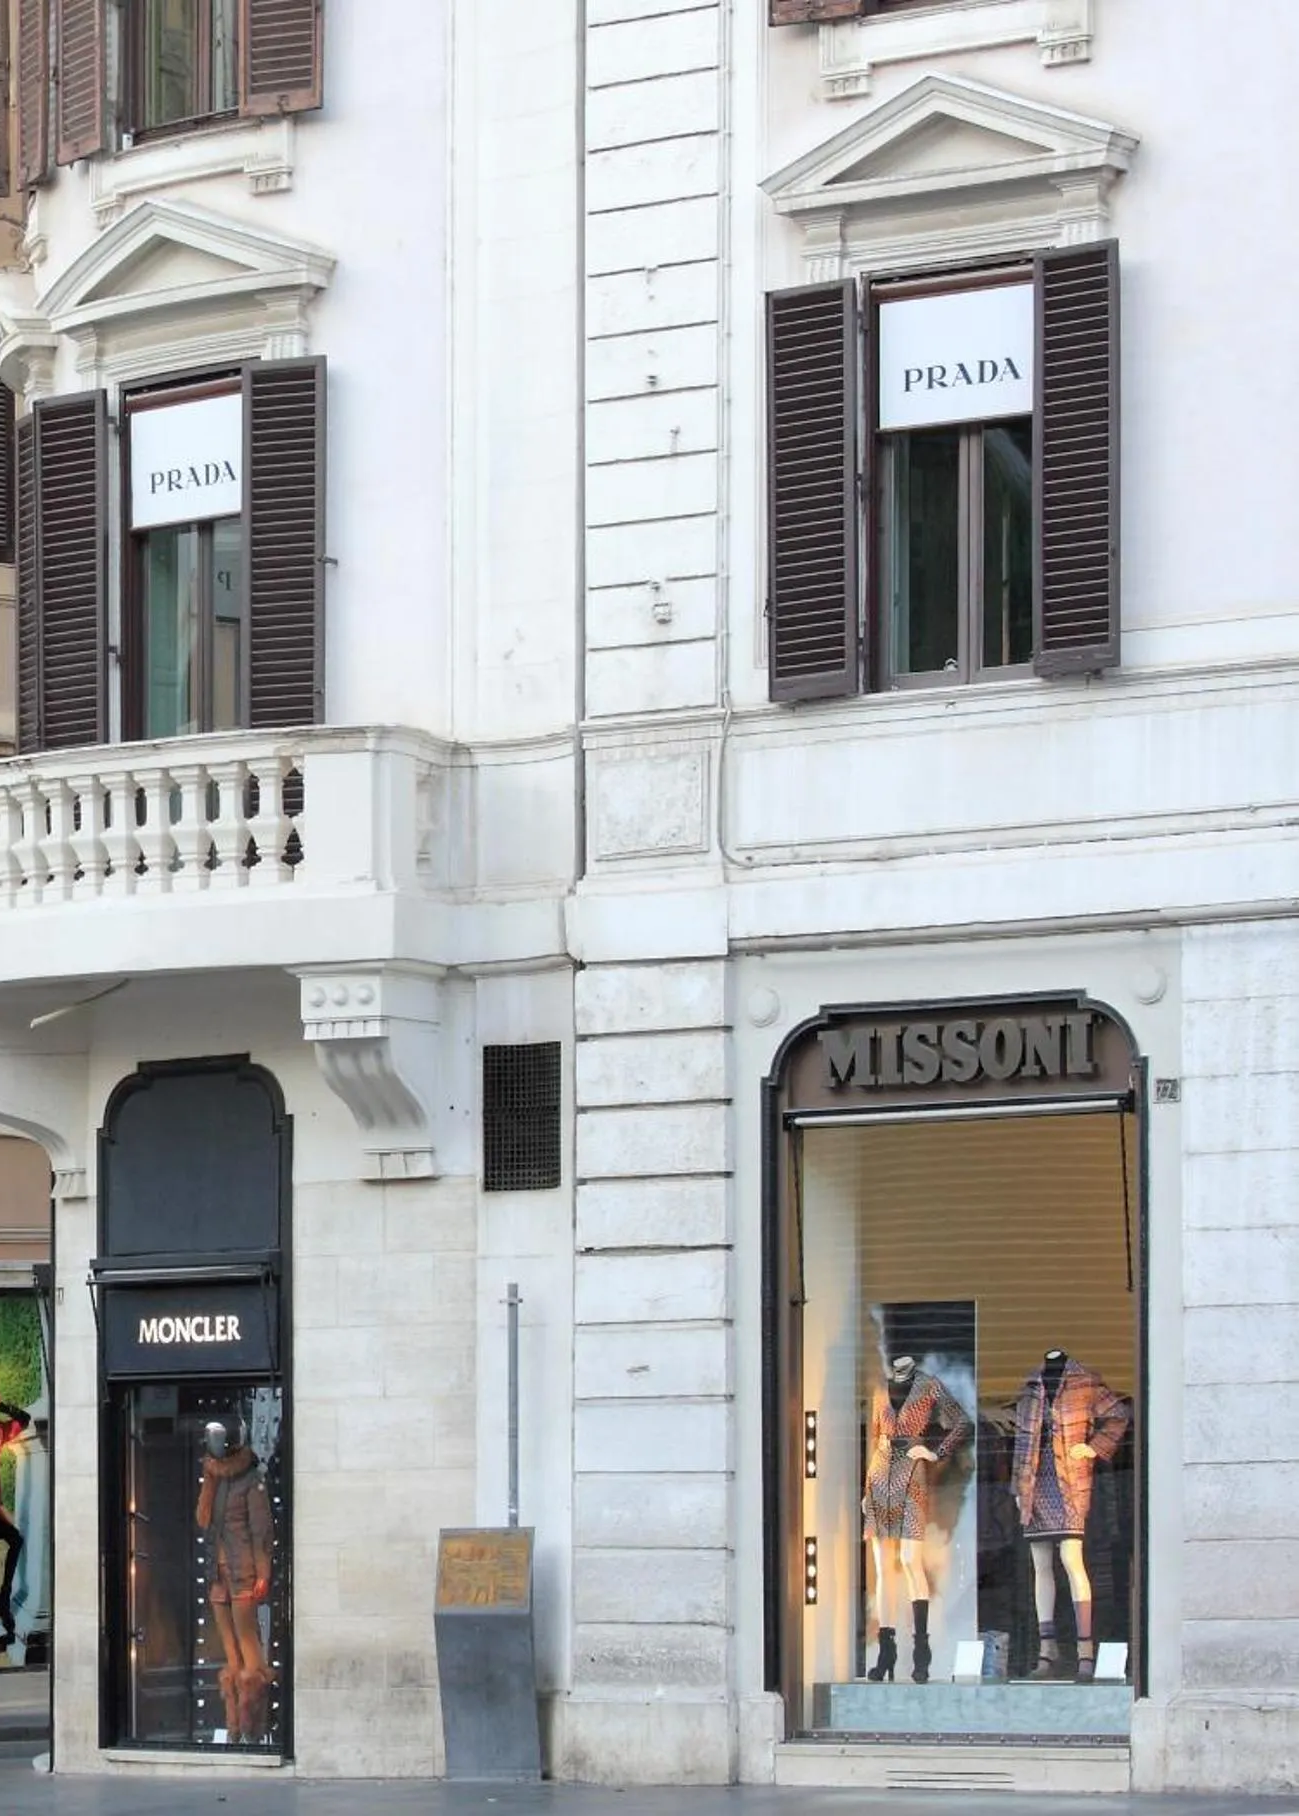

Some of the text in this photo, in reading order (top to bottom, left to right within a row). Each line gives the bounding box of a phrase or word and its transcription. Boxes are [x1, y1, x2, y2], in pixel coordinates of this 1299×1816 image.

[903, 357, 1022, 393] PRADA
[150, 460, 236, 494] PRADA
[817, 1013, 1098, 1087] MISSONI
[138, 1315, 242, 1344] MONCLER
